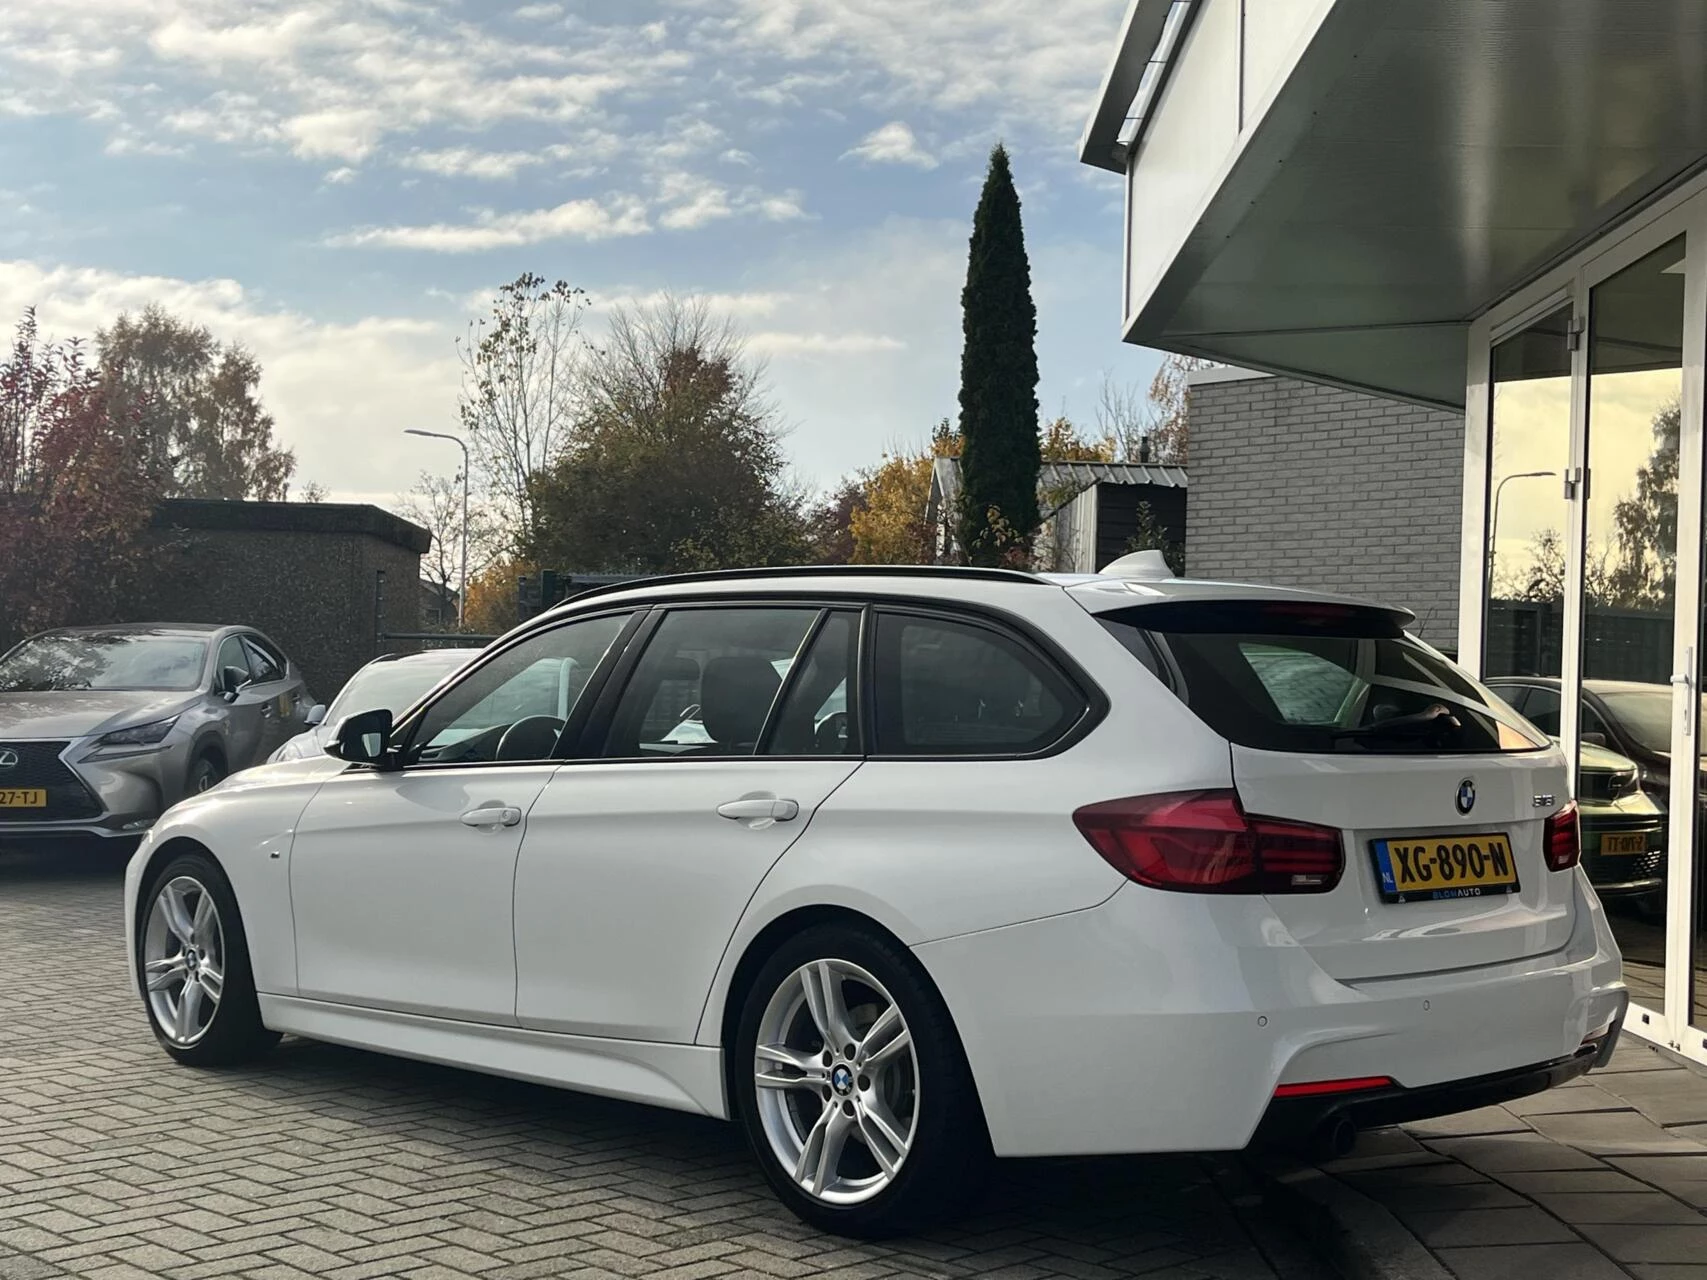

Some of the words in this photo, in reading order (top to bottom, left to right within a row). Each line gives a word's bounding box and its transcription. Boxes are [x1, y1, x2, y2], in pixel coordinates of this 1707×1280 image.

[0, 791, 38, 805] 27-TJ
[1394, 842, 1509, 884] XG-890-N
[1381, 872, 1394, 884] NL
